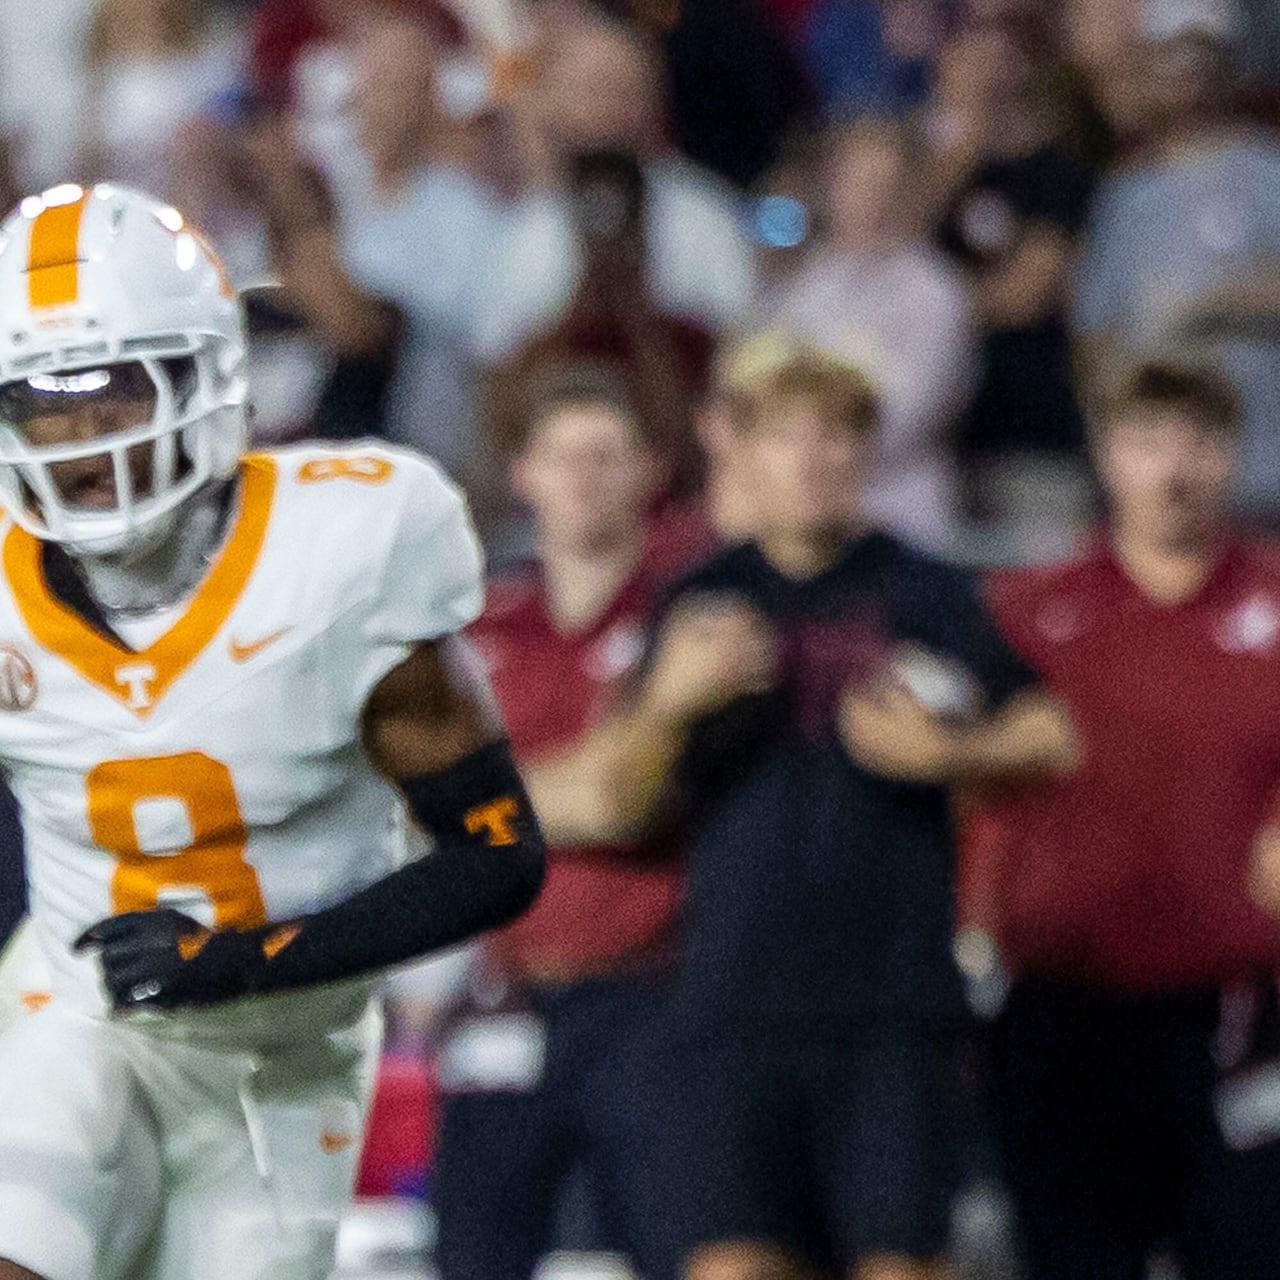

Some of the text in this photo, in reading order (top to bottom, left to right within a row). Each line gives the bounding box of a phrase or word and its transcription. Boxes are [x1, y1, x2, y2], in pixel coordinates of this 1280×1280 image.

[297, 454, 394, 485] 8
[115, 664, 157, 707] T
[86, 751, 267, 932] 8
[464, 797, 518, 846] T
